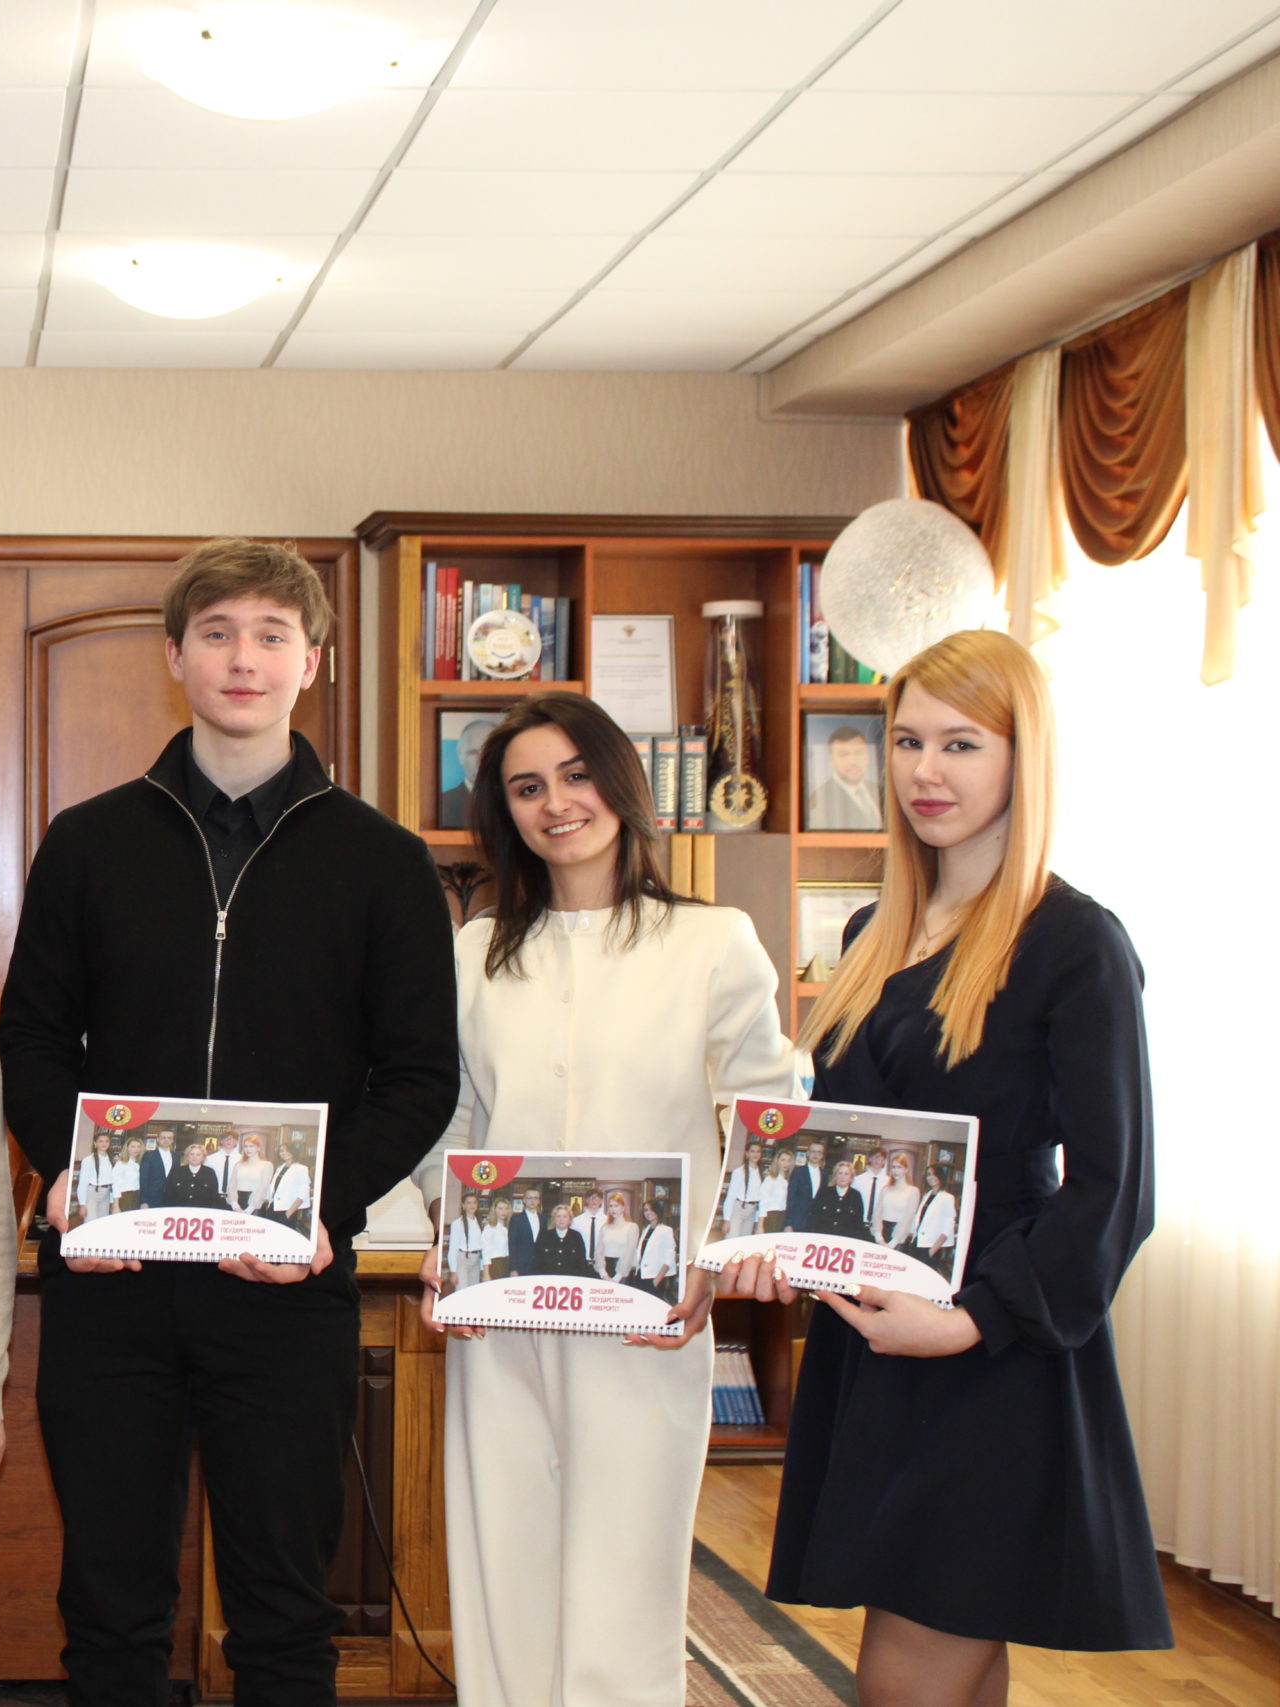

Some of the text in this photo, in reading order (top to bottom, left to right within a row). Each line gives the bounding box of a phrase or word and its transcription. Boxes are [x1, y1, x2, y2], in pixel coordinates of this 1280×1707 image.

[162, 1217, 214, 1241] 2026
[802, 1243, 856, 1274] 2026
[532, 1285, 583, 1311] 2026
[589, 1296, 634, 1304] ГОСУДАРСТВЕННЫЙ
